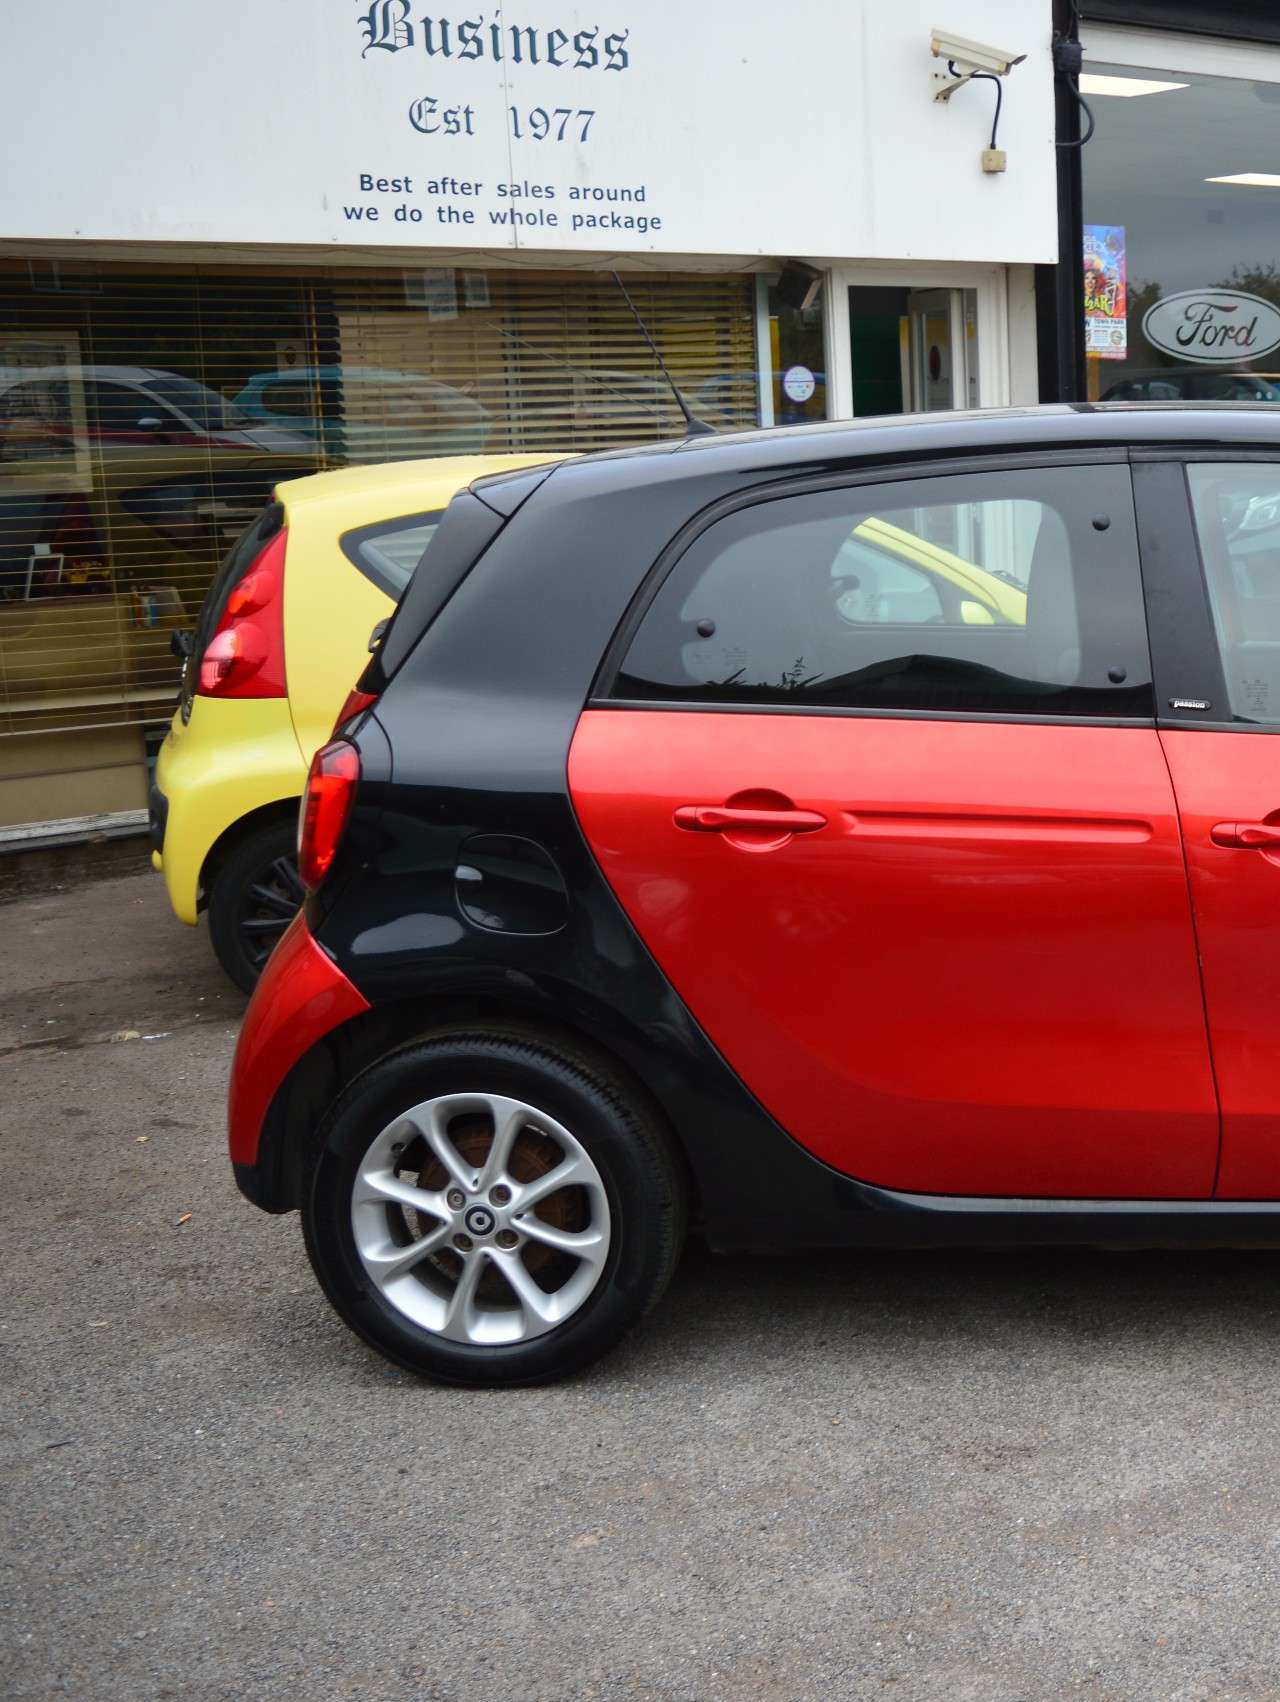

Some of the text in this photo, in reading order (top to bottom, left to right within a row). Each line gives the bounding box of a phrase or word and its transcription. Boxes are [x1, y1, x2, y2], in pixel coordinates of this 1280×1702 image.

[358, 0, 629, 71] Business
[409, 96, 596, 142] Est 1977
[360, 174, 646, 202] Best after sales around
[343, 204, 662, 233] we do the whole package
[1176, 302, 1258, 347] Ford
